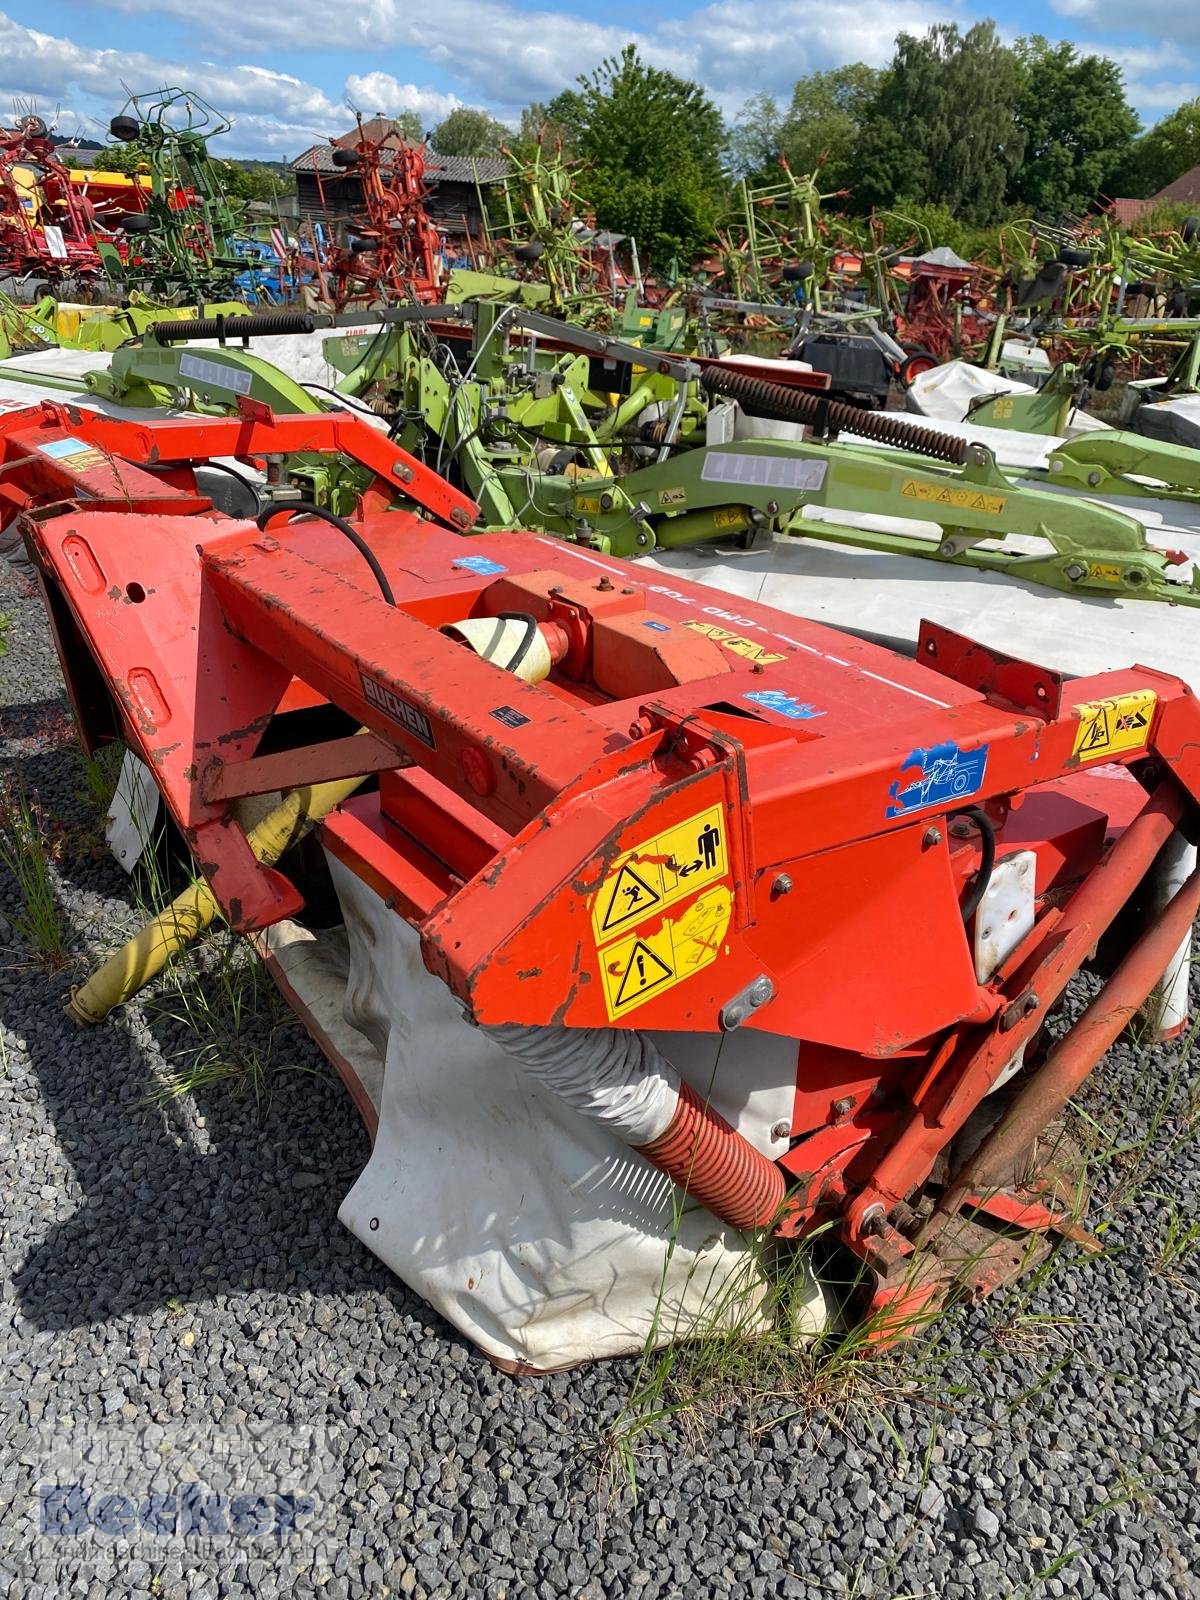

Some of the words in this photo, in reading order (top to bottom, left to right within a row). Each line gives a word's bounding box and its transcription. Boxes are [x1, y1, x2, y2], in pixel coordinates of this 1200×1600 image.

[181, 354, 251, 393] CLAAS
[703, 453, 826, 489] CLAAS
[647, 585, 697, 605] 702
[701, 606, 757, 627] GMD
[362, 675, 430, 738] BUCHEN
